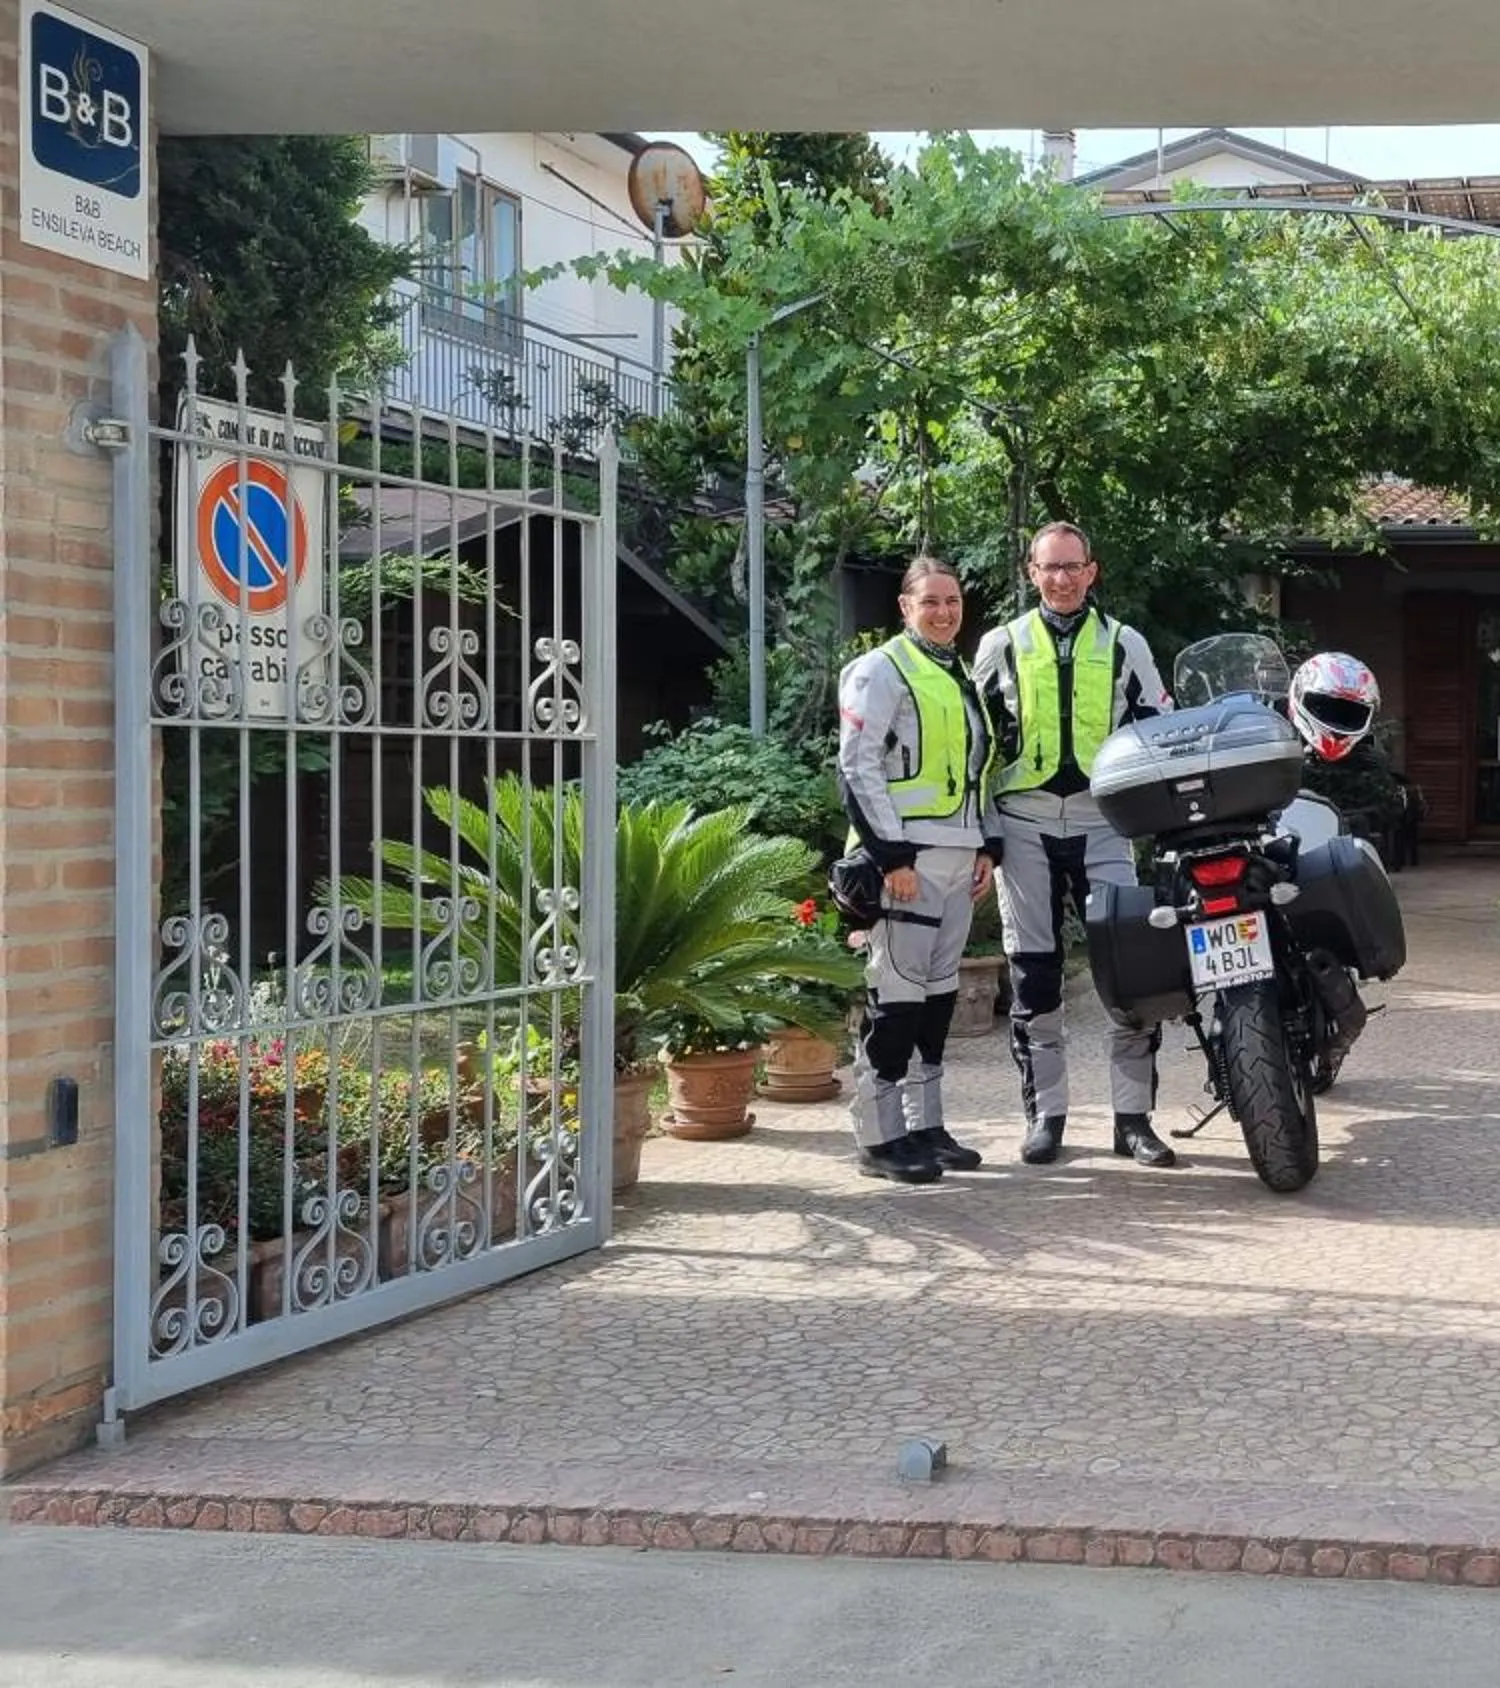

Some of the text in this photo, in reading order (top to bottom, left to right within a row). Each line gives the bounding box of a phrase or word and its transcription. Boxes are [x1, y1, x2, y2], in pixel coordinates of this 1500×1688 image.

[39, 63, 132, 147] B&B
[75, 195, 101, 219] B&B
[32, 208, 141, 260] ENSILEVA BEACH
[1207, 923, 1237, 949] WO
[1206, 946, 1259, 975] 4 BJL
